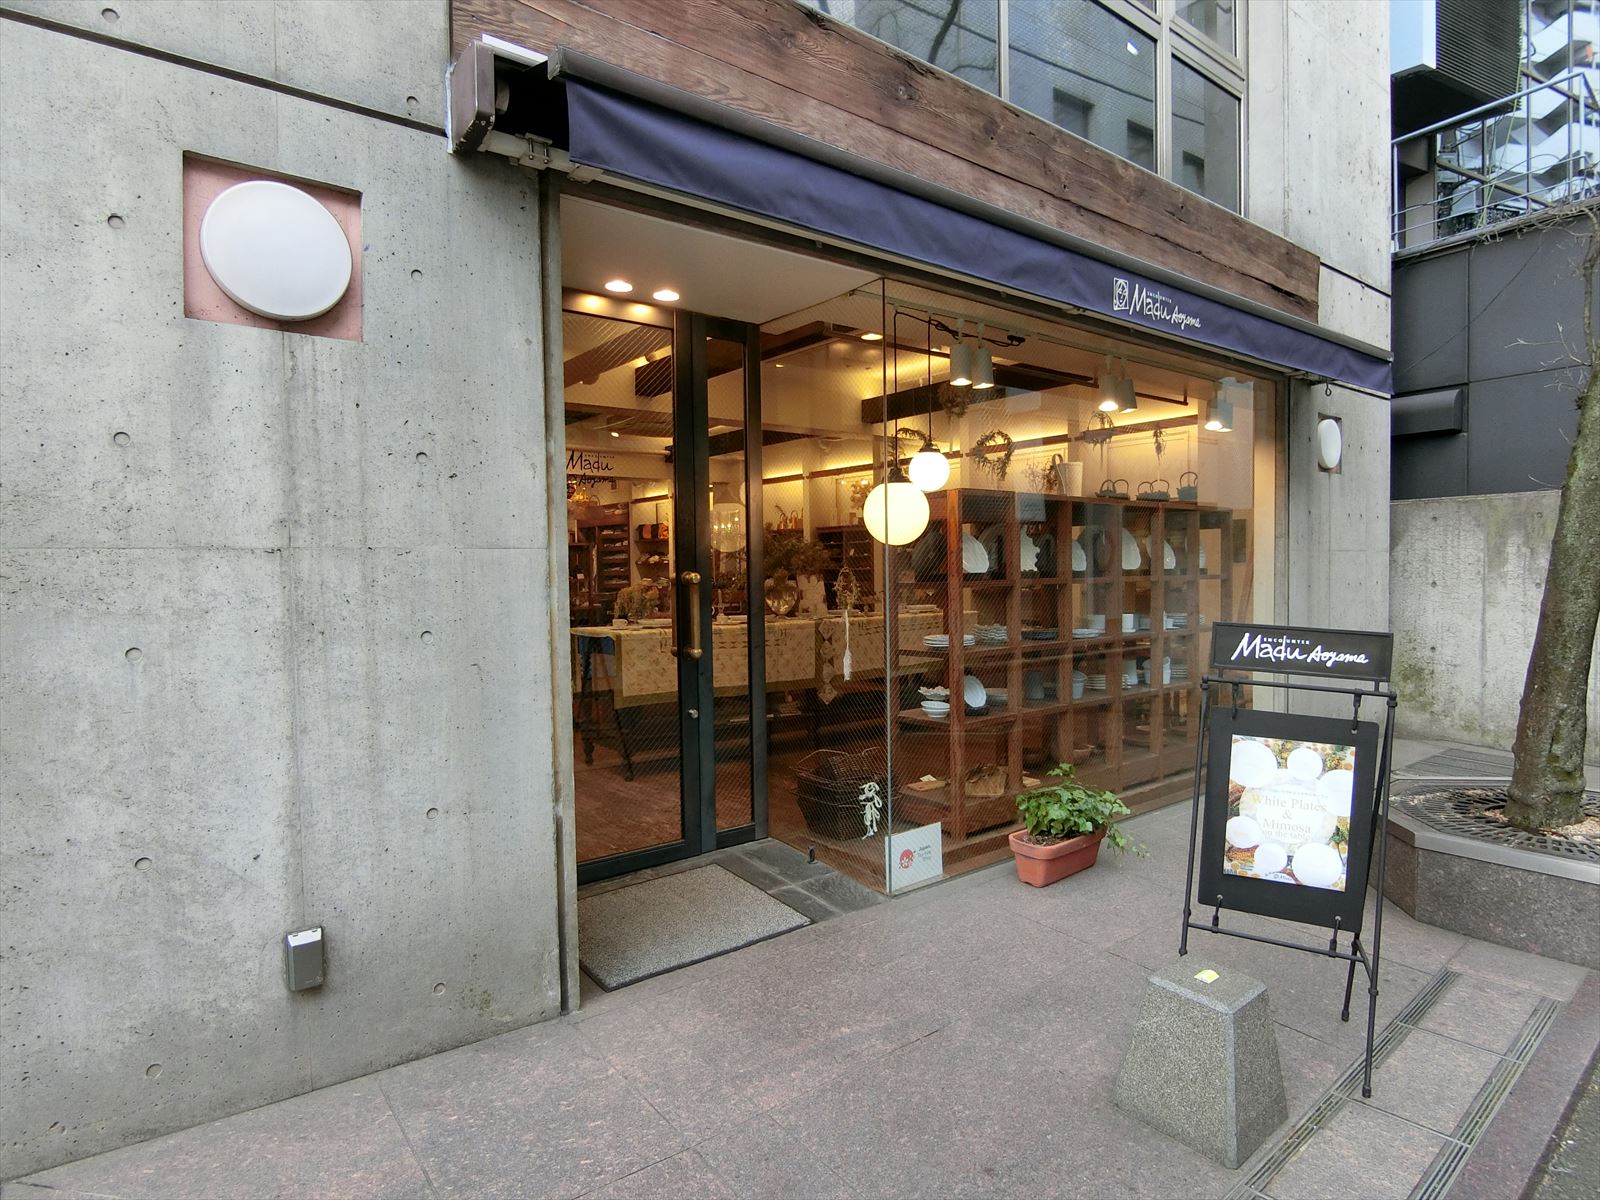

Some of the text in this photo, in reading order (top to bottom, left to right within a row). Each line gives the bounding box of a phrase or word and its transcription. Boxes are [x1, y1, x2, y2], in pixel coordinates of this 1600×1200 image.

[1129, 283, 1201, 330] Madu Aoyama
[566, 450, 614, 473] Madu
[1231, 632, 1369, 667] Madu Aoyama
[1282, 809, 1293, 820] &
[1292, 798, 1327, 812] Plates
[1263, 818, 1311, 834] Mimosa
